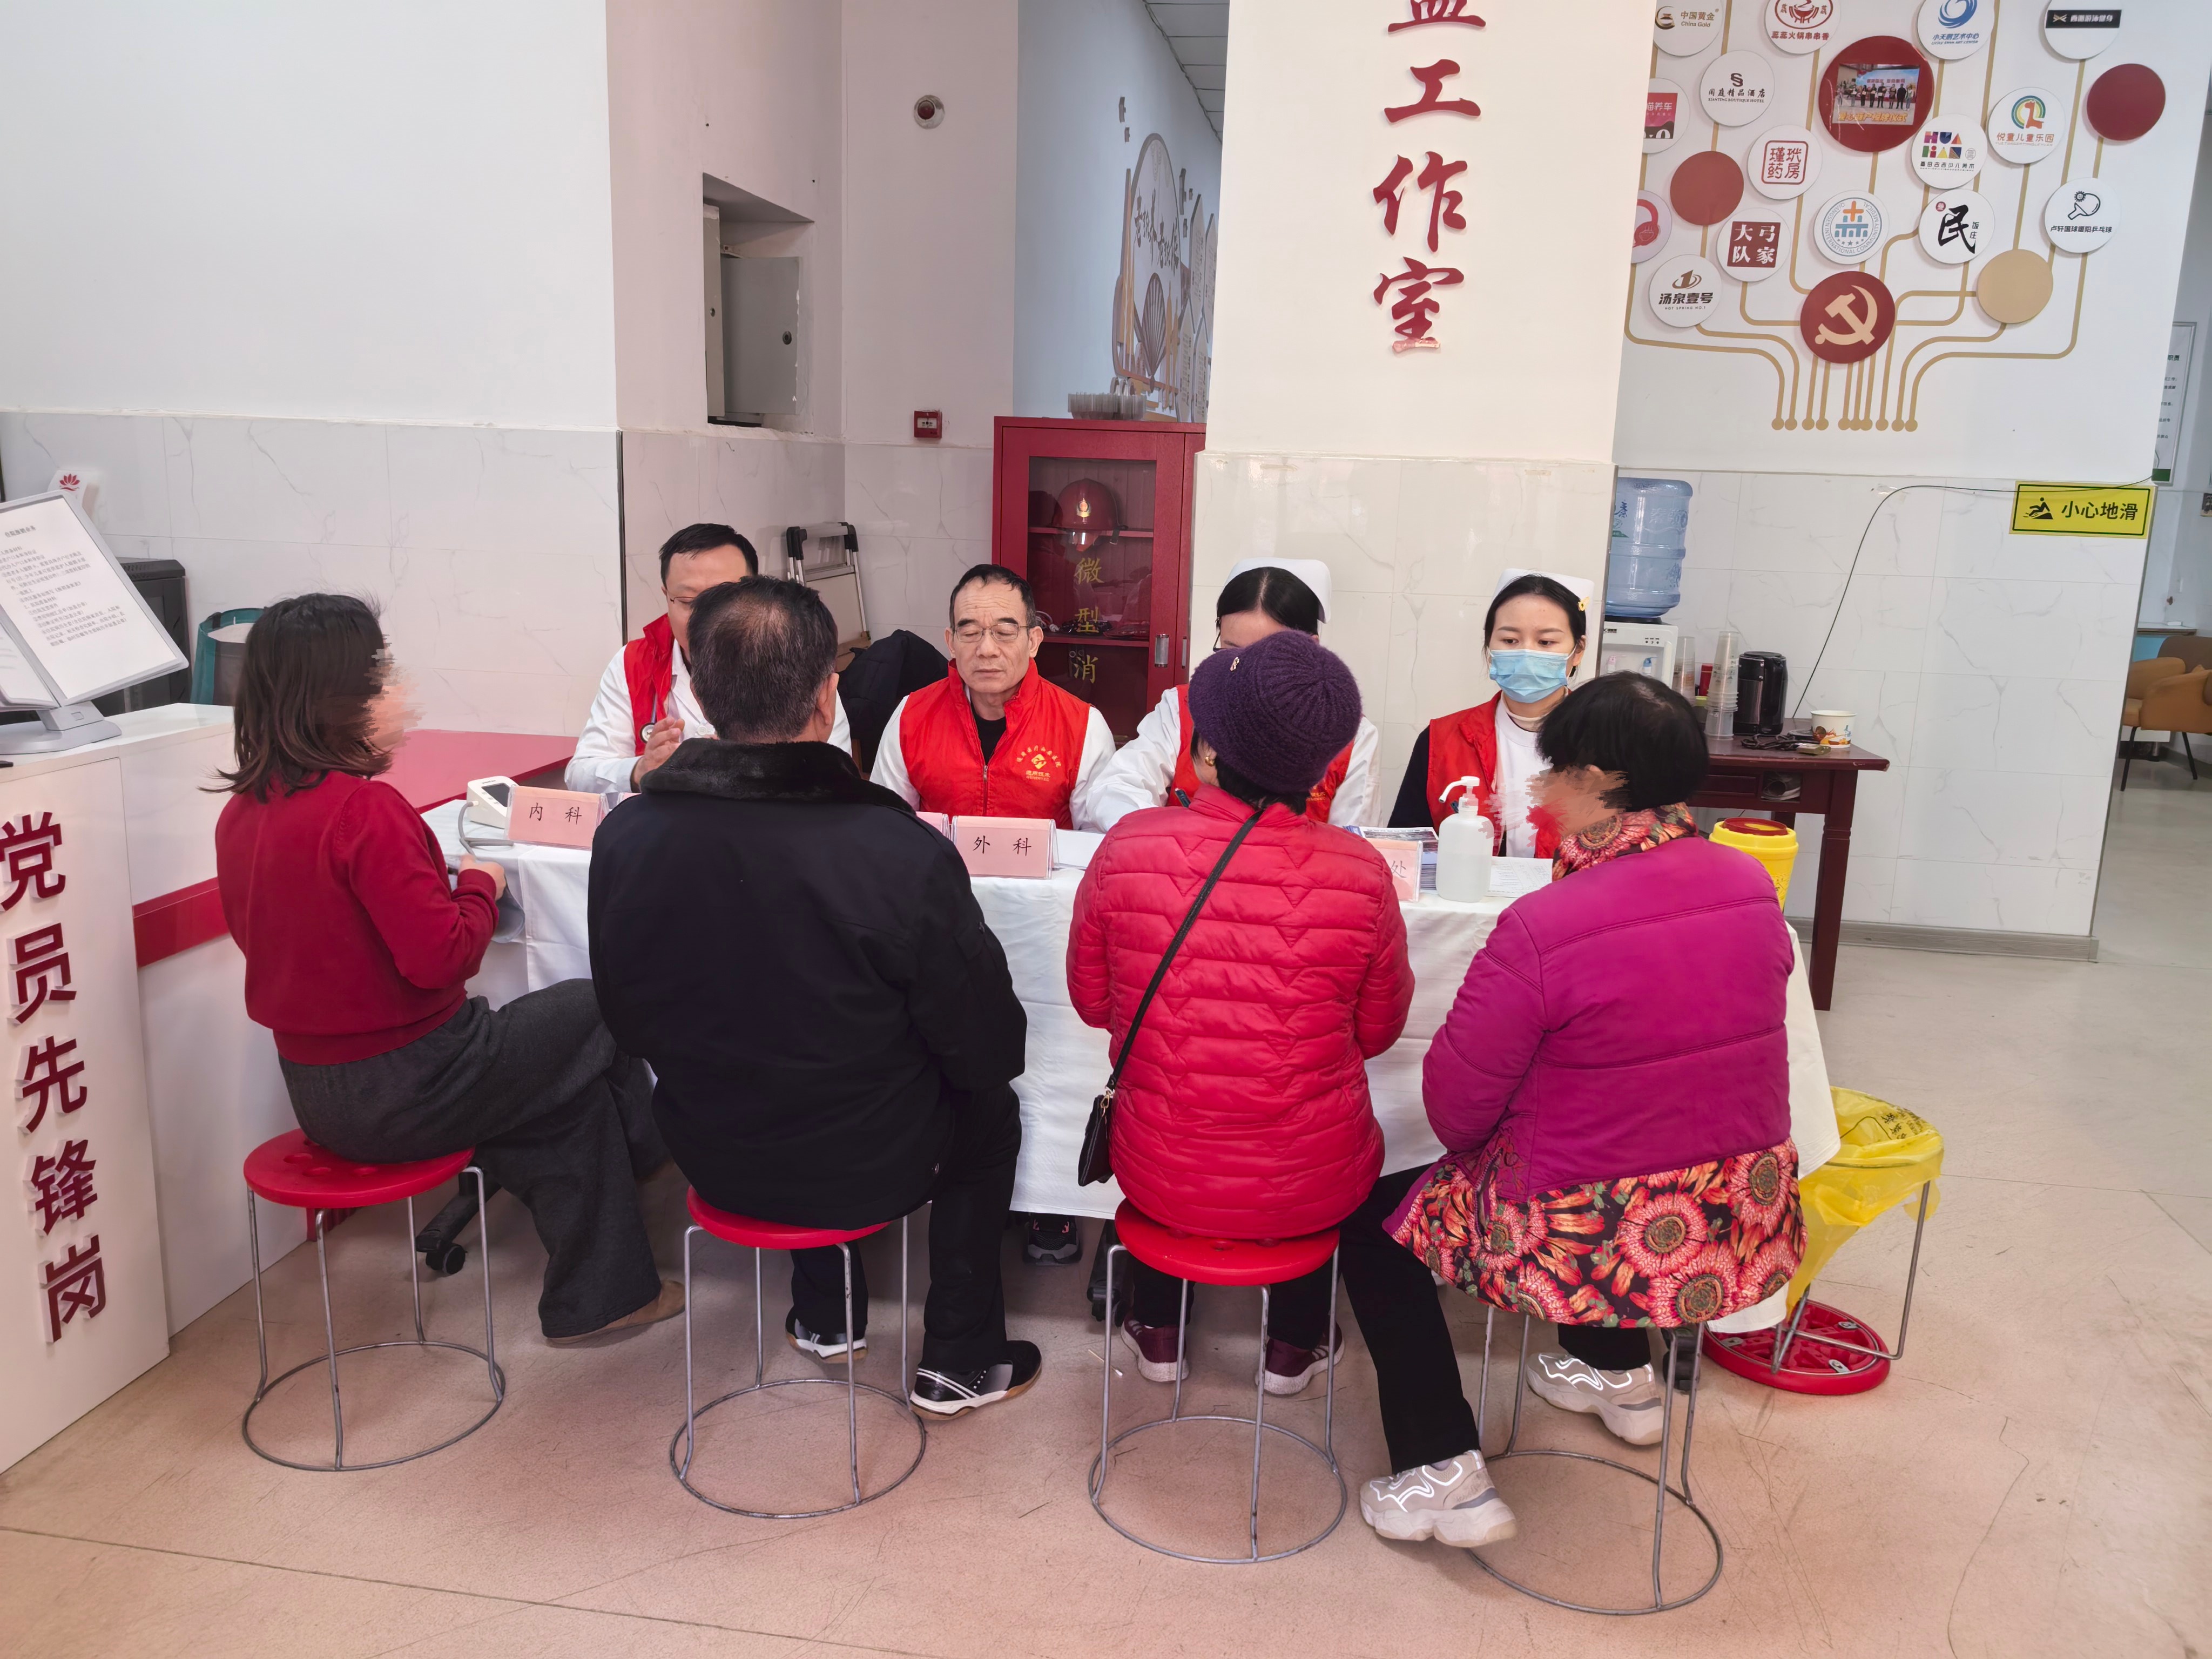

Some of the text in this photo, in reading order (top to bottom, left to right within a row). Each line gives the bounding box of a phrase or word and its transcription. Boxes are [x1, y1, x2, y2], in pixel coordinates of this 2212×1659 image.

[1681, 11, 1715, 21] 中国黄金
[1997, 132, 2054, 143] 悦童儿童乐园
[1864, 202, 1879, 223] MEDICAL
[1857, 223, 1879, 253] COMMUNITY
[1938, 204, 1976, 254] 民
[1970, 221, 1980, 239] 饭庄
[1824, 227, 1855, 254] INTERNATIONAL
[1658, 292, 1714, 305] 汤泉壹号
[2061, 500, 2139, 521] 小心地滑
[1026, 770, 1051, 778] 通用技术
[0, 810, 107, 1345] 党员先锋岗
